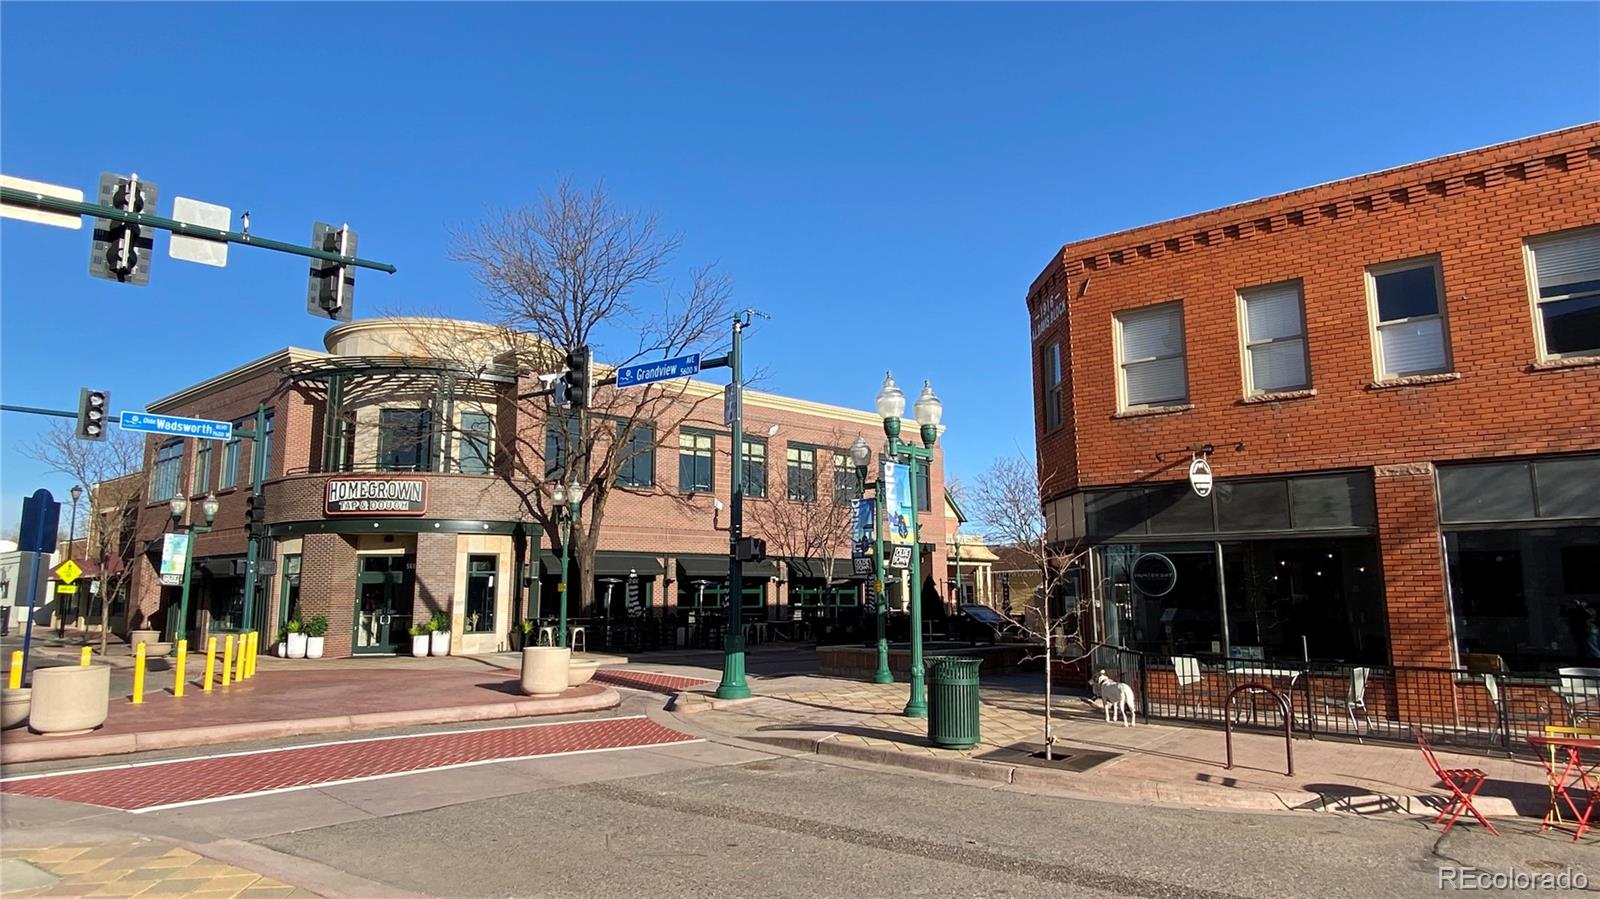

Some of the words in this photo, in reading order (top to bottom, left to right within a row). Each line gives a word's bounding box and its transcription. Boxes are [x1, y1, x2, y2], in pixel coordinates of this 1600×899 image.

[686, 355, 695, 364] AVE
[636, 364, 677, 381] Grandview
[680, 365, 693, 376] 5600
[156, 419, 212, 434] Wadsworth
[329, 481, 423, 502] HOMEGROWN
[339, 500, 360, 511] TAP
[359, 500, 369, 511] &
[369, 500, 409, 511] DOUGH
